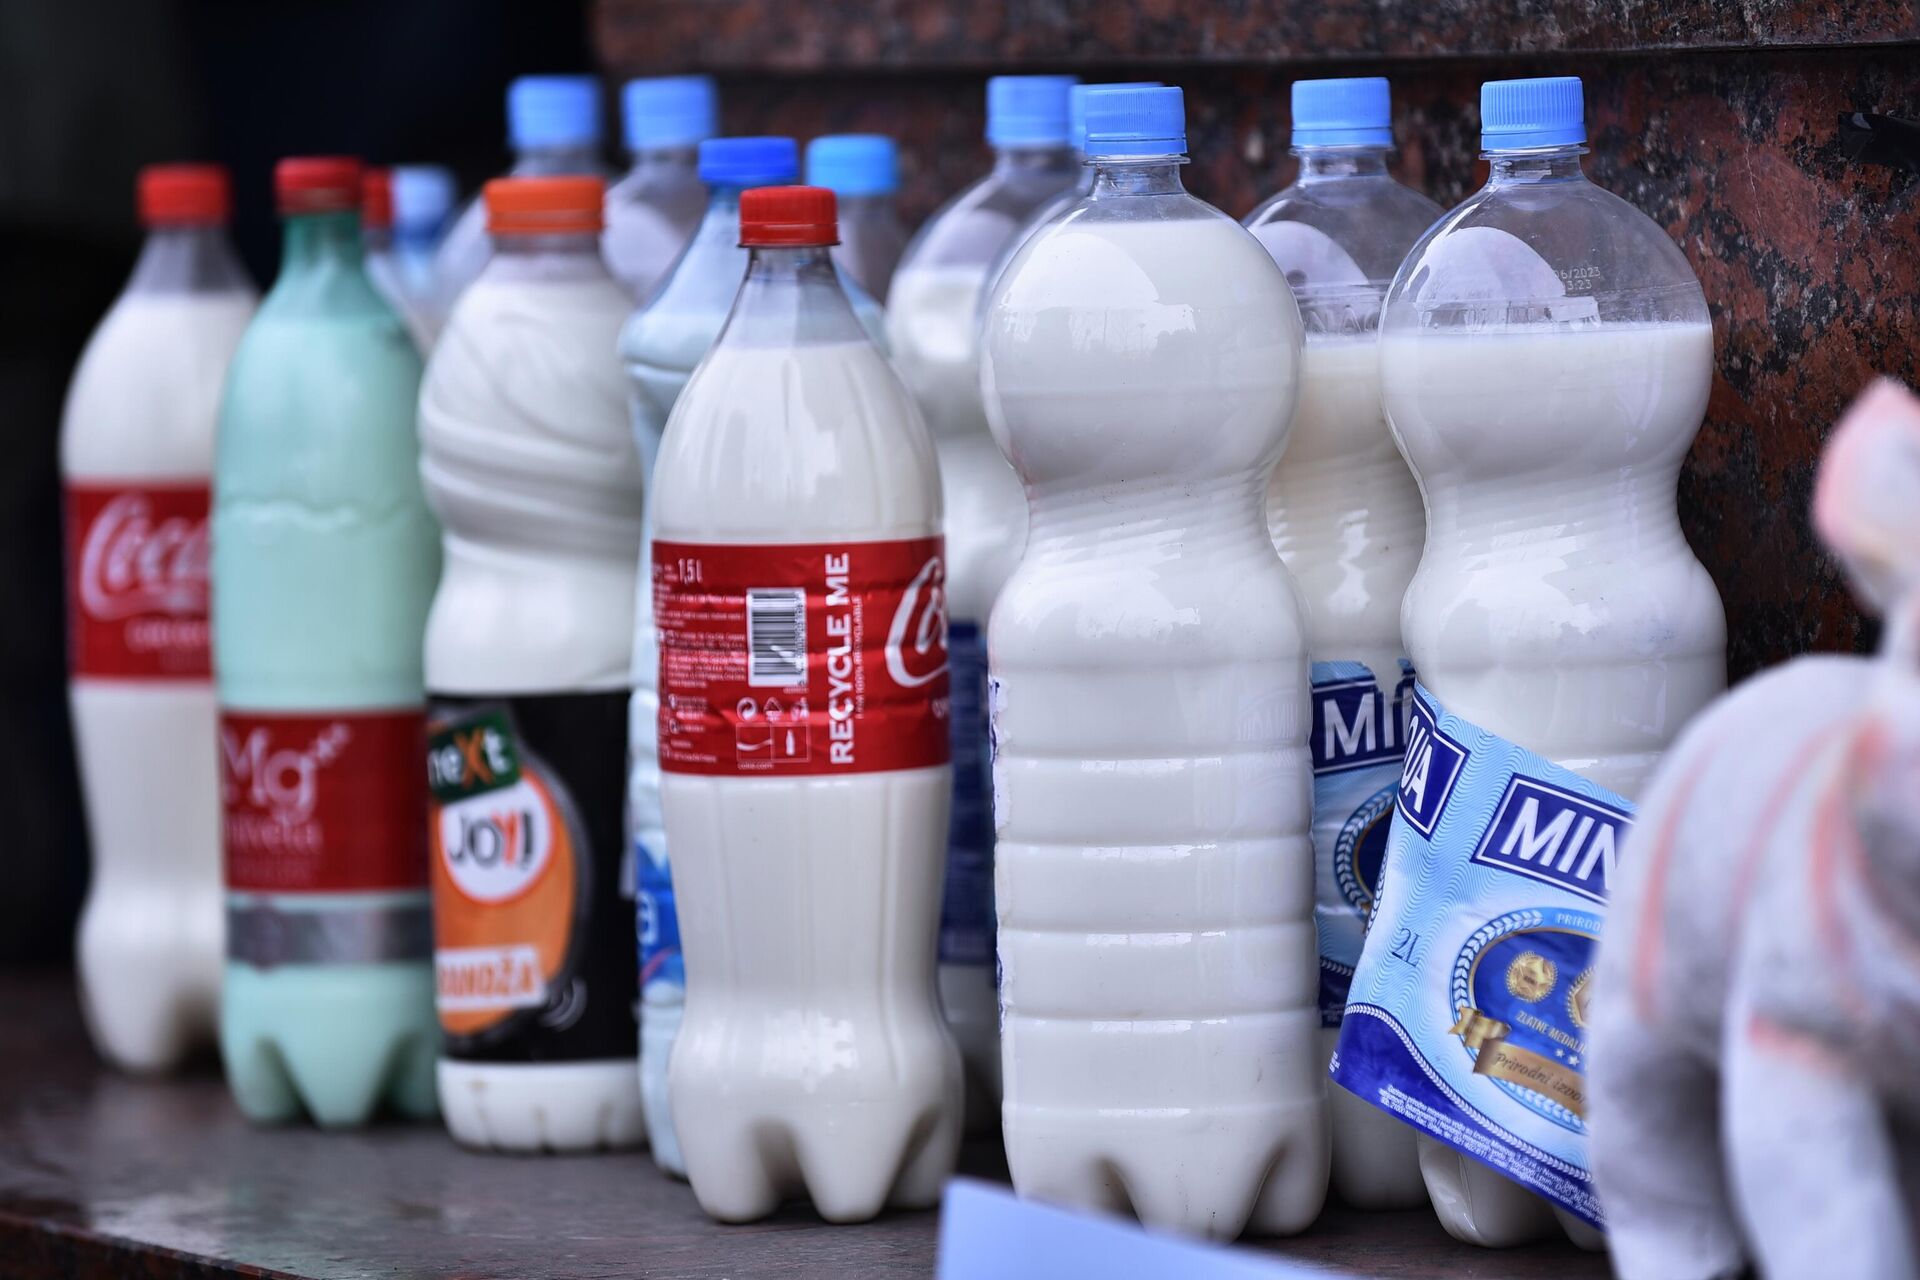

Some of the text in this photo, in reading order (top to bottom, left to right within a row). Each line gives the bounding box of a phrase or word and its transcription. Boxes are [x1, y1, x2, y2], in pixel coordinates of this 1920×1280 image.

[825, 553, 855, 763] RECYCLE ME
[1391, 927, 1423, 968] 2L
[1516, 1010, 1549, 1035] ZLATNE
[1495, 1053, 1551, 1086] Prirodni
